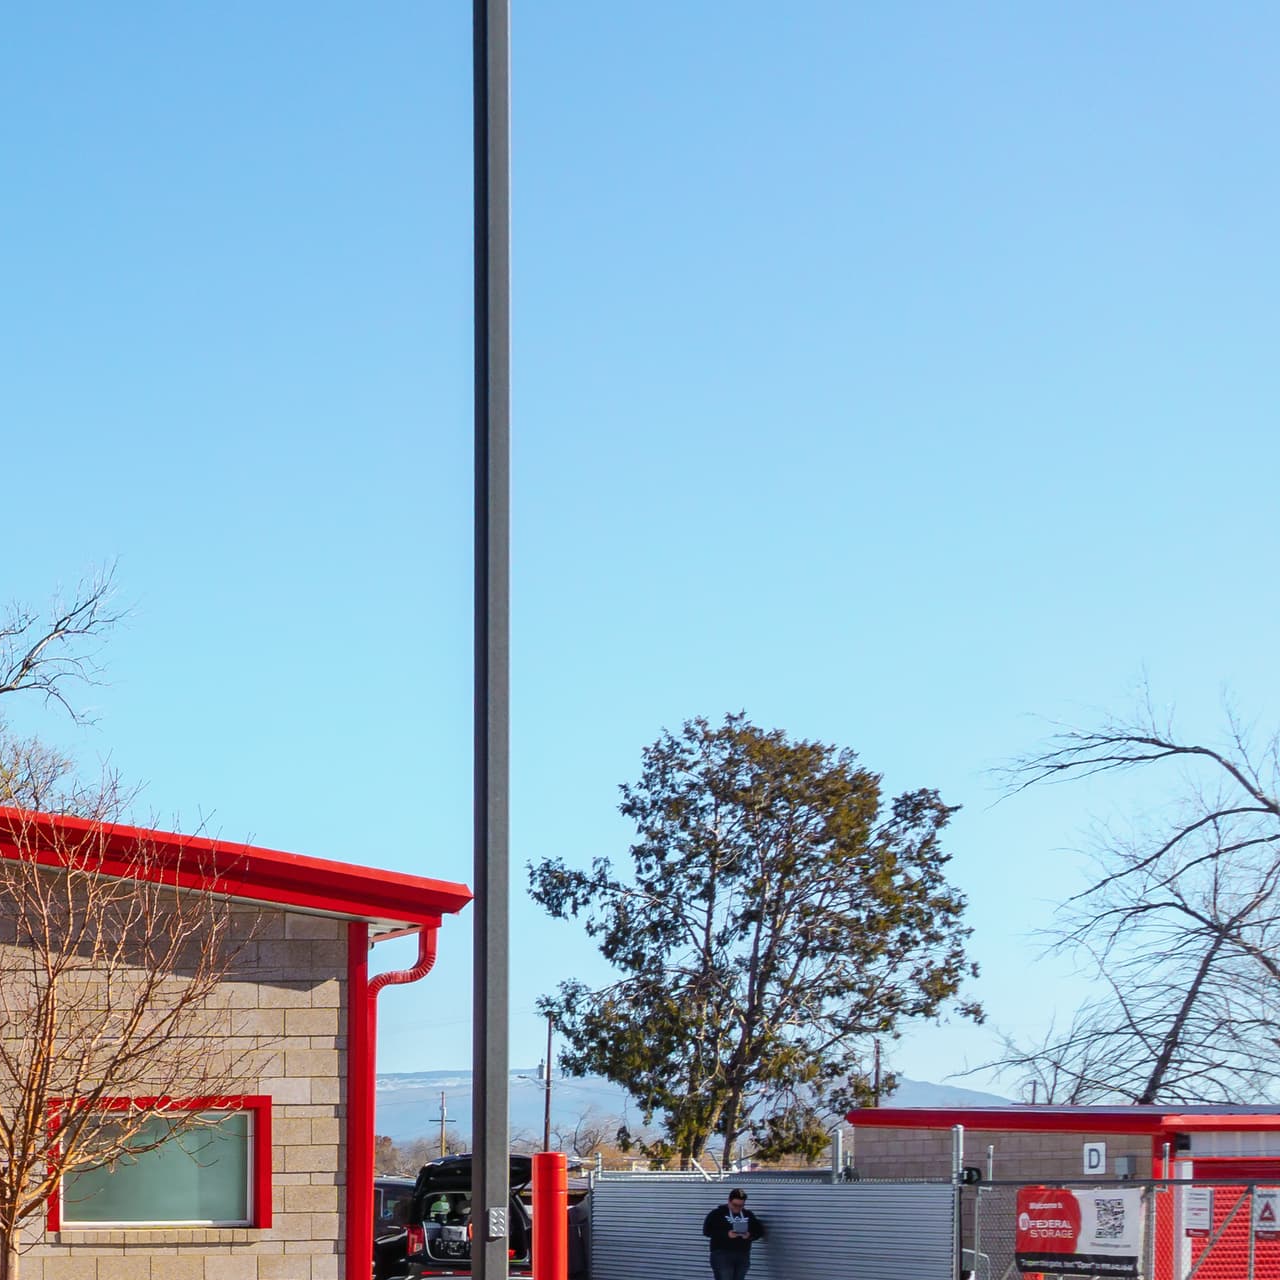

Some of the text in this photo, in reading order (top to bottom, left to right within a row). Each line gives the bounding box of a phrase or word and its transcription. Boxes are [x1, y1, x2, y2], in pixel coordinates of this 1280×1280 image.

[1087, 1148, 1101, 1169] D
[1028, 1219, 1073, 1229] FEDERAL
[1030, 1229, 1073, 1239] STORAGE
